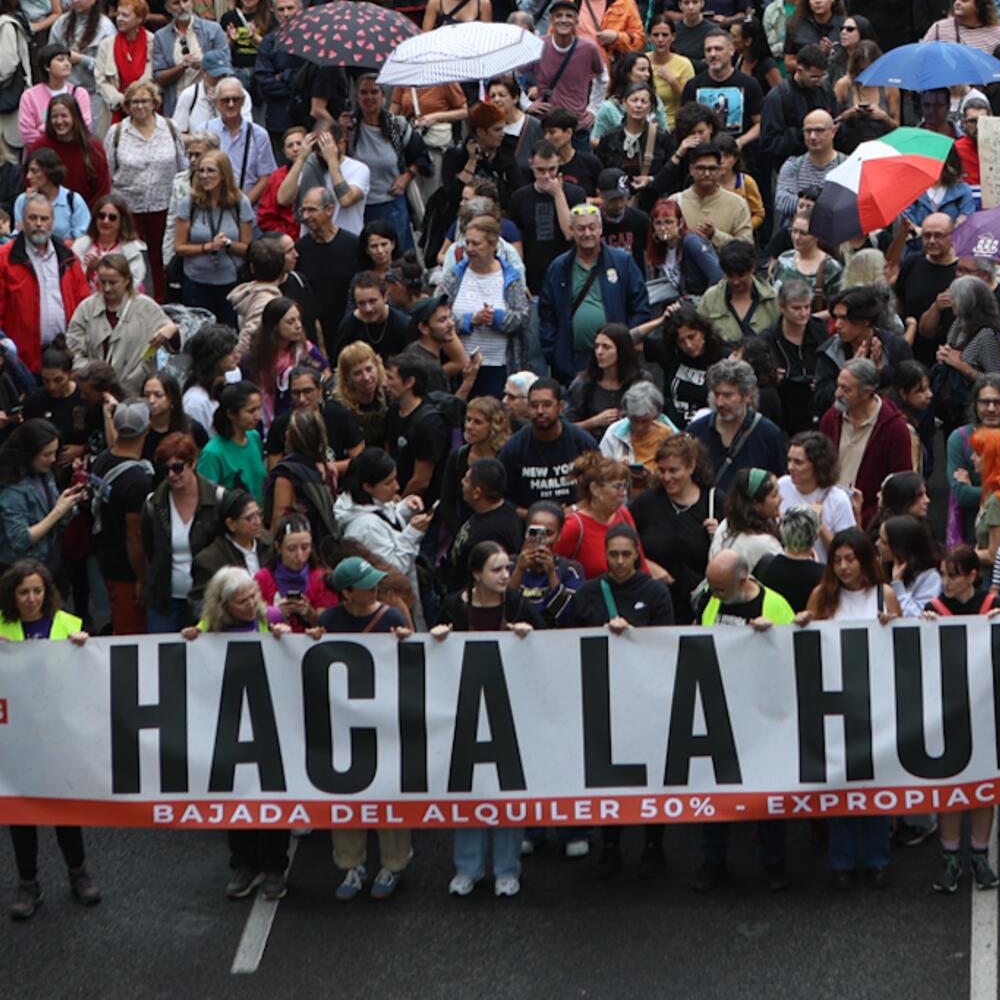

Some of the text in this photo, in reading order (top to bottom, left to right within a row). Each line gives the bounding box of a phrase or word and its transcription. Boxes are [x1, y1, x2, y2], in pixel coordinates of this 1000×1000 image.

[521, 462, 576, 478] NEW YOR
[110, 640, 527, 794] HACIA
[580, 633, 743, 788] LA
[153, 803, 312, 825] BAJADA
[331, 802, 404, 824] DEL
[422, 796, 620, 826] ALQUILER
[640, 797, 716, 819] 50%
